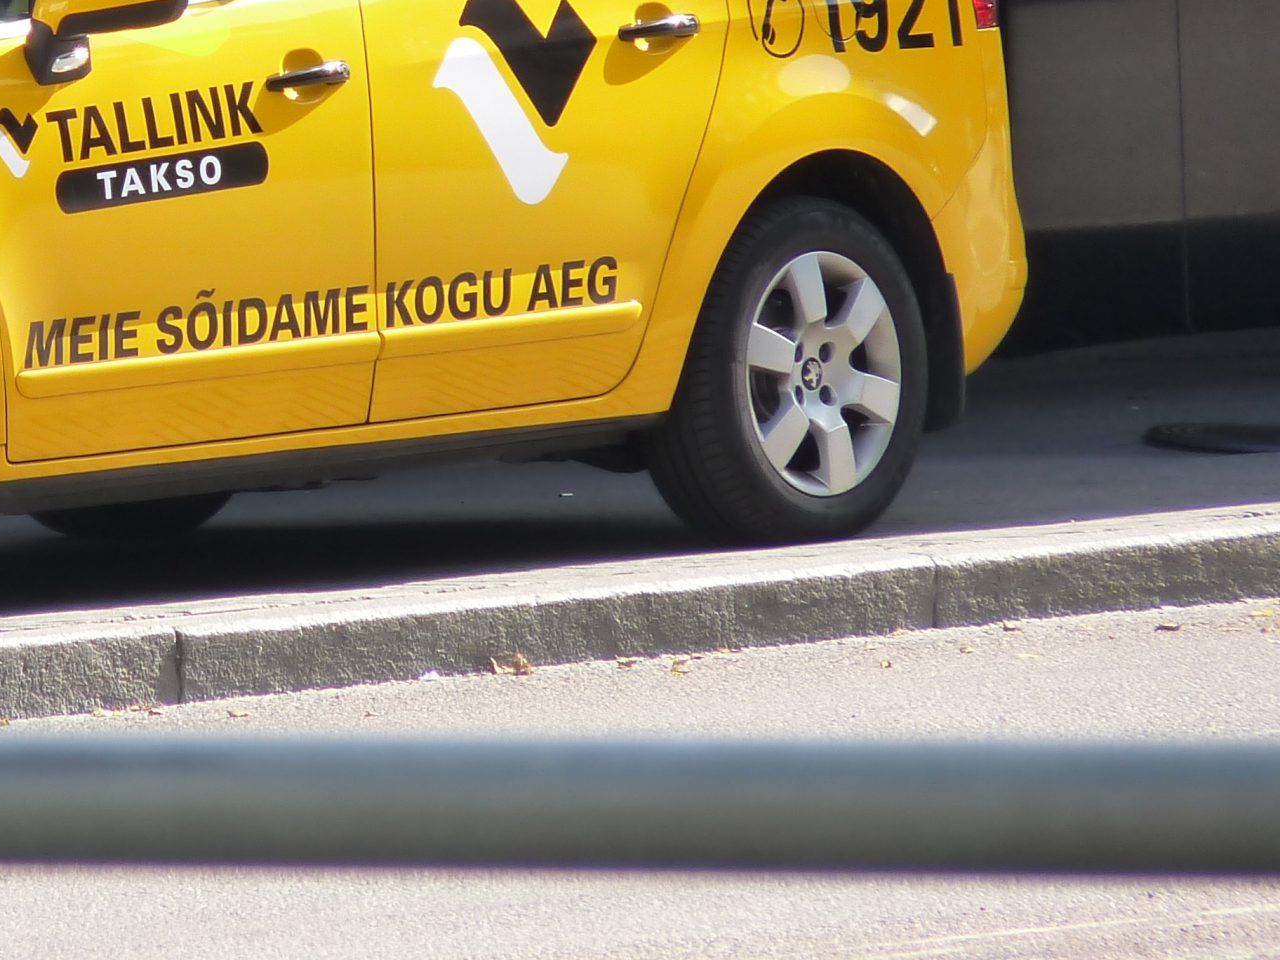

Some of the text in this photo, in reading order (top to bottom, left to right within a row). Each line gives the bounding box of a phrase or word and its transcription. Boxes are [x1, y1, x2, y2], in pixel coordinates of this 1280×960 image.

[46, 81, 264, 162] TALLINK
[96, 155, 221, 200] TAKSO
[24, 256, 618, 369] MEIE SÕIDAME KOGU AEG
